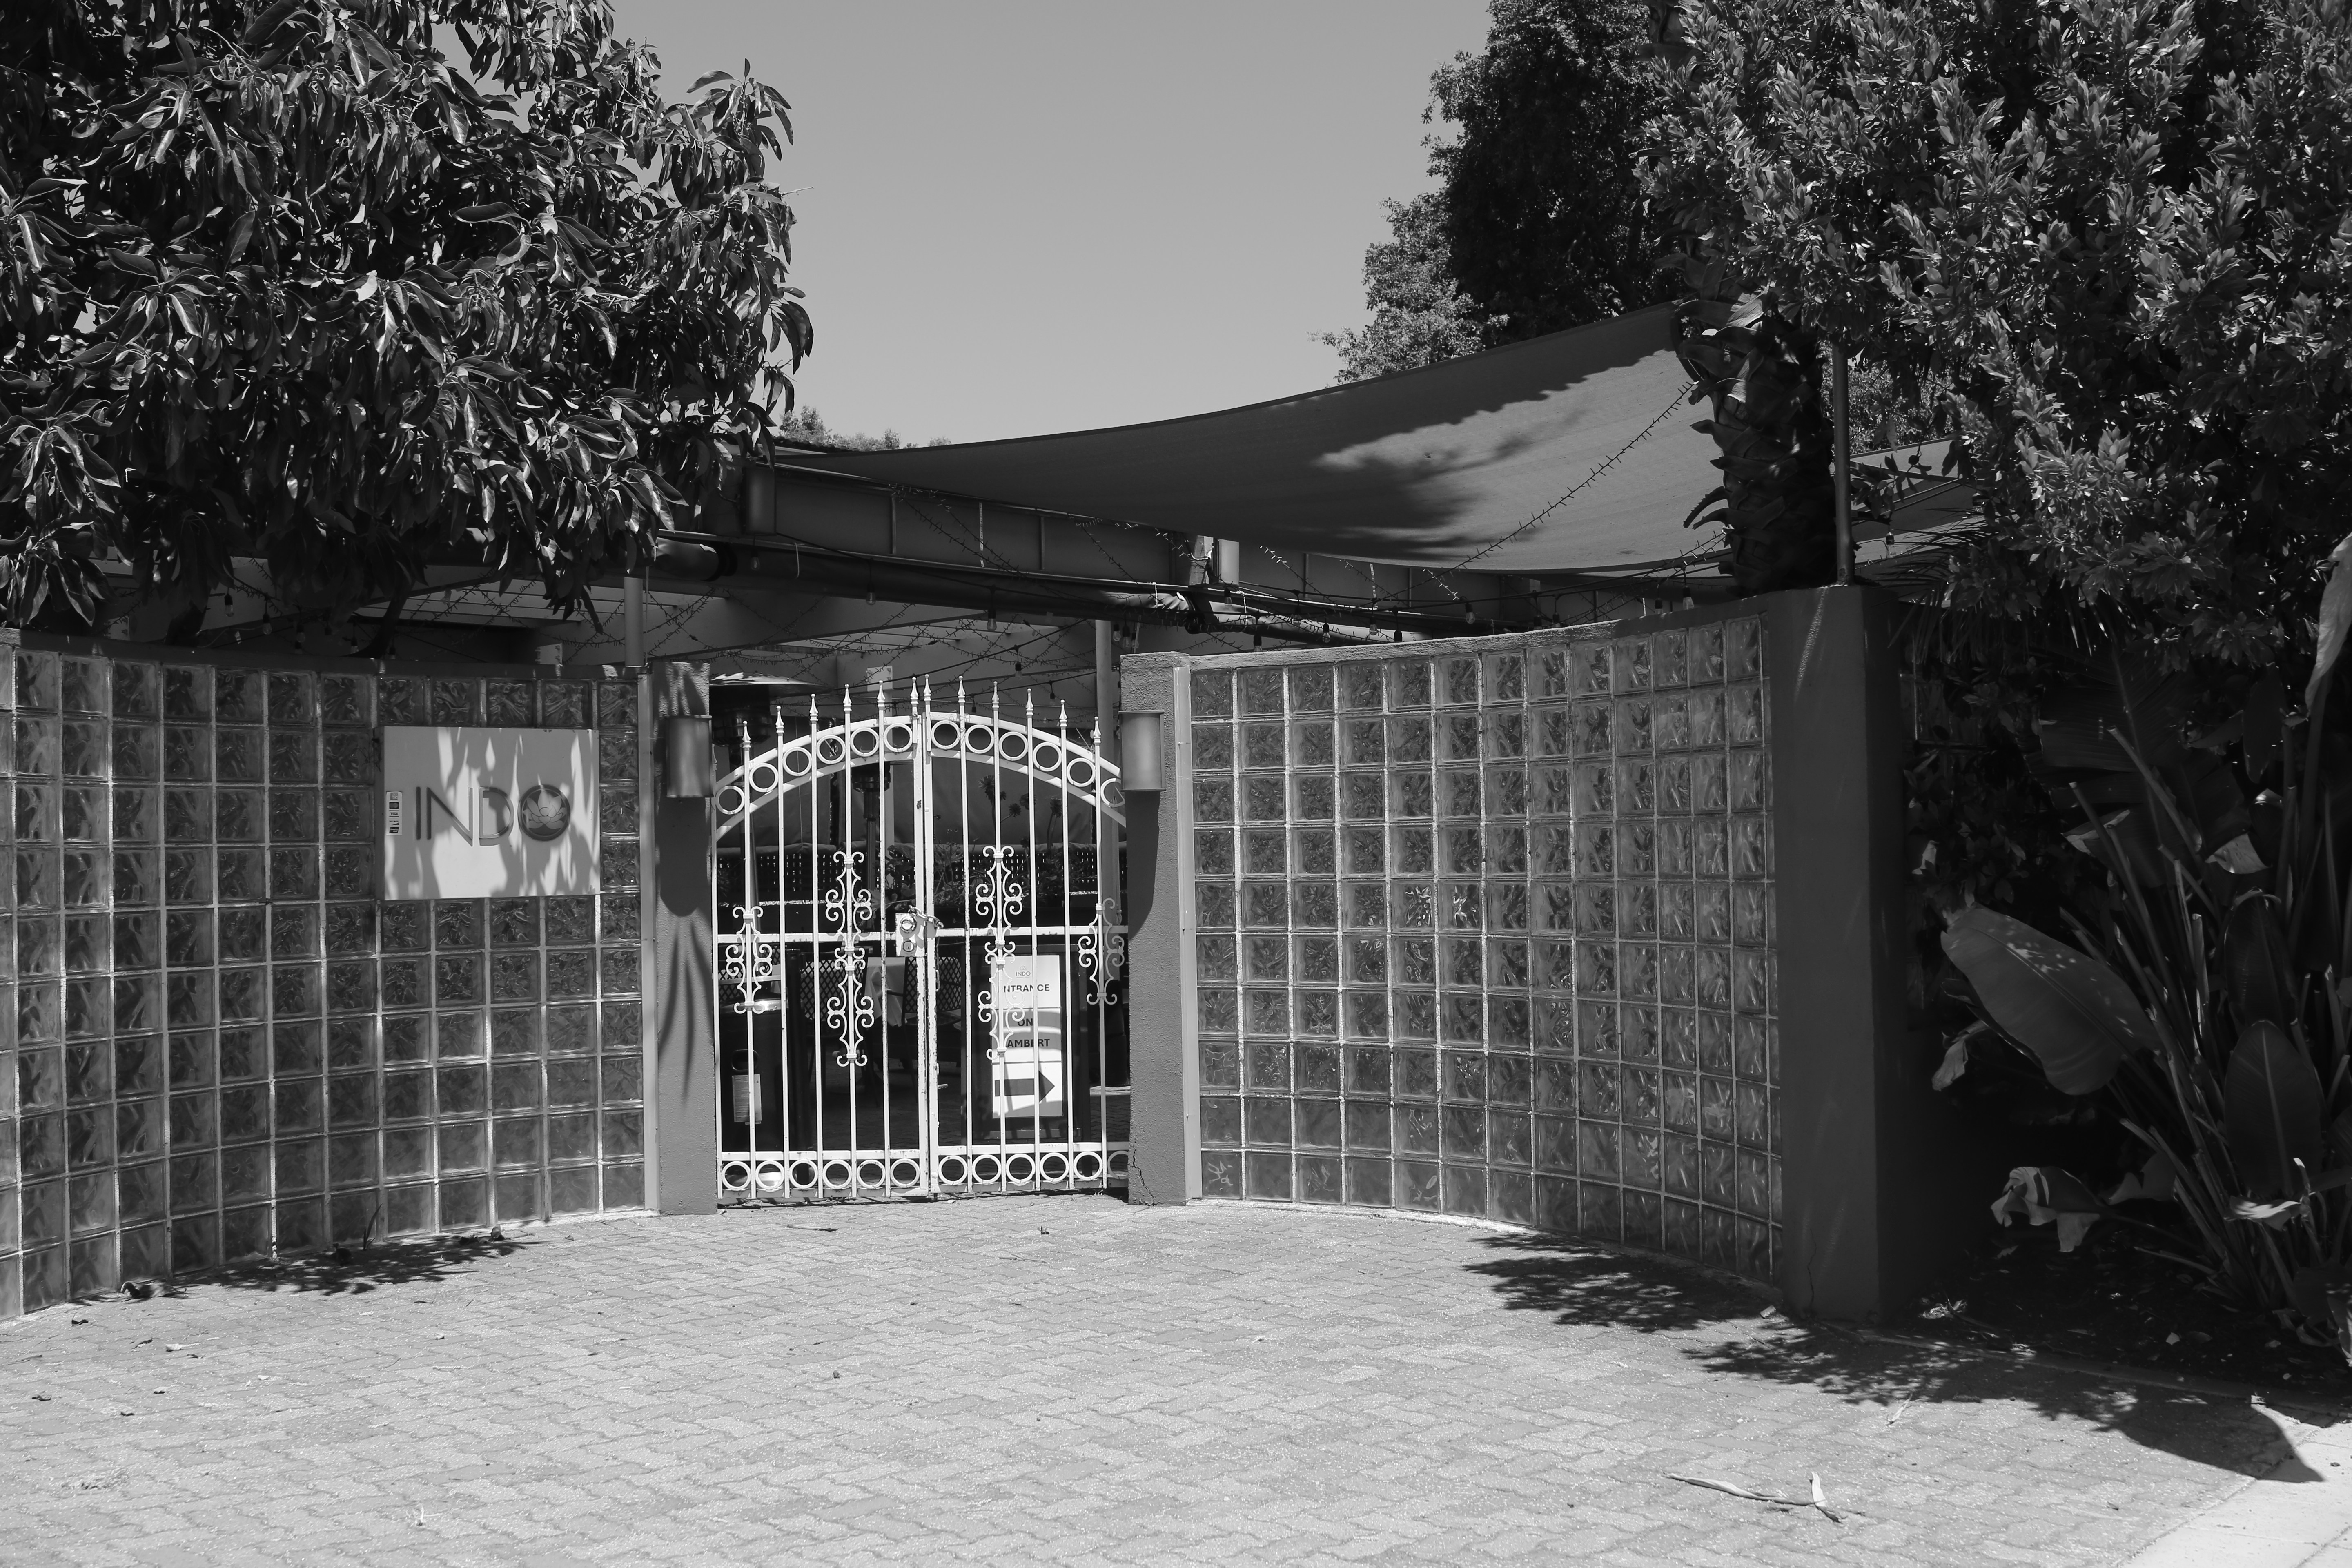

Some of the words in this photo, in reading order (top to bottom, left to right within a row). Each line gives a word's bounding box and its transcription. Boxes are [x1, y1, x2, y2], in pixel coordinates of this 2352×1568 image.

[416, 784, 571, 842] INDO
[998, 984, 1050, 993] NTRANCE
[1017, 1018, 1033, 1027] ON
[1006, 1039, 1050, 1048] AMBERT
